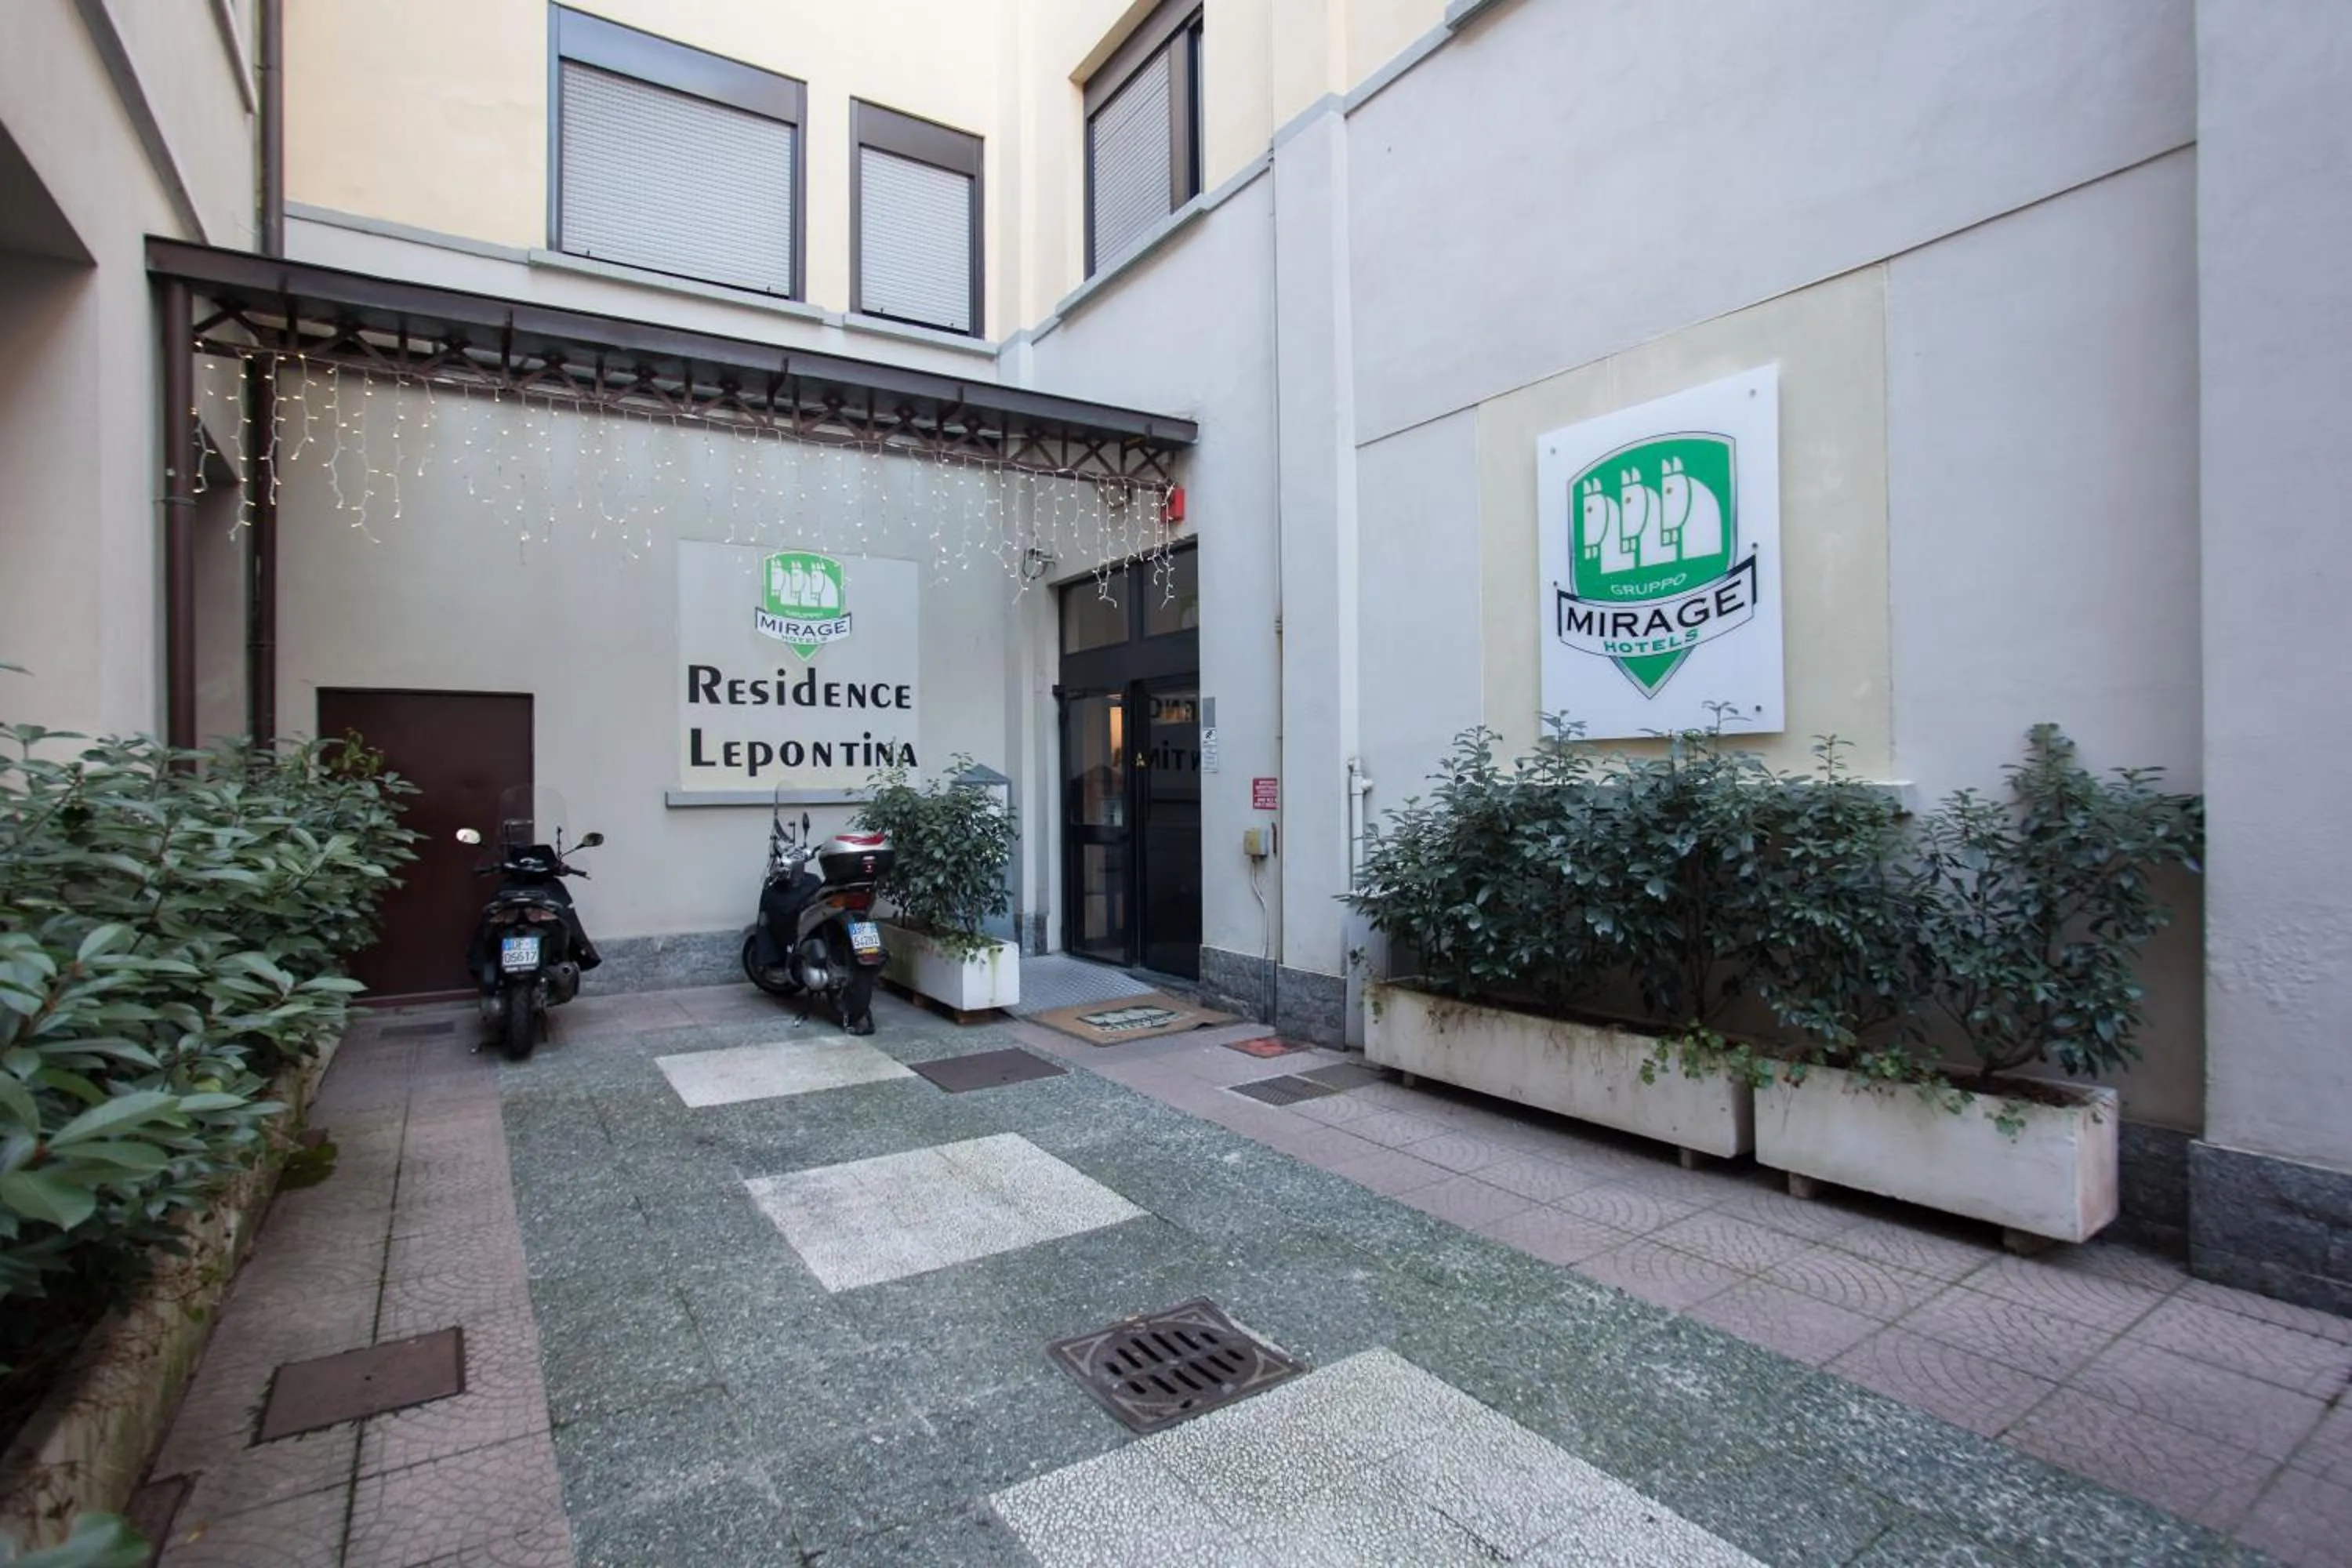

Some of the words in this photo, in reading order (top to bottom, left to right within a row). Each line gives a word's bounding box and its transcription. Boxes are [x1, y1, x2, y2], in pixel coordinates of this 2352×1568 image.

[1610, 573, 1687, 595] GRUPPO
[1566, 579, 1745, 637] MIRAGE
[760, 615, 847, 637] MIRAGE
[1603, 628, 1699, 653] HOTELS
